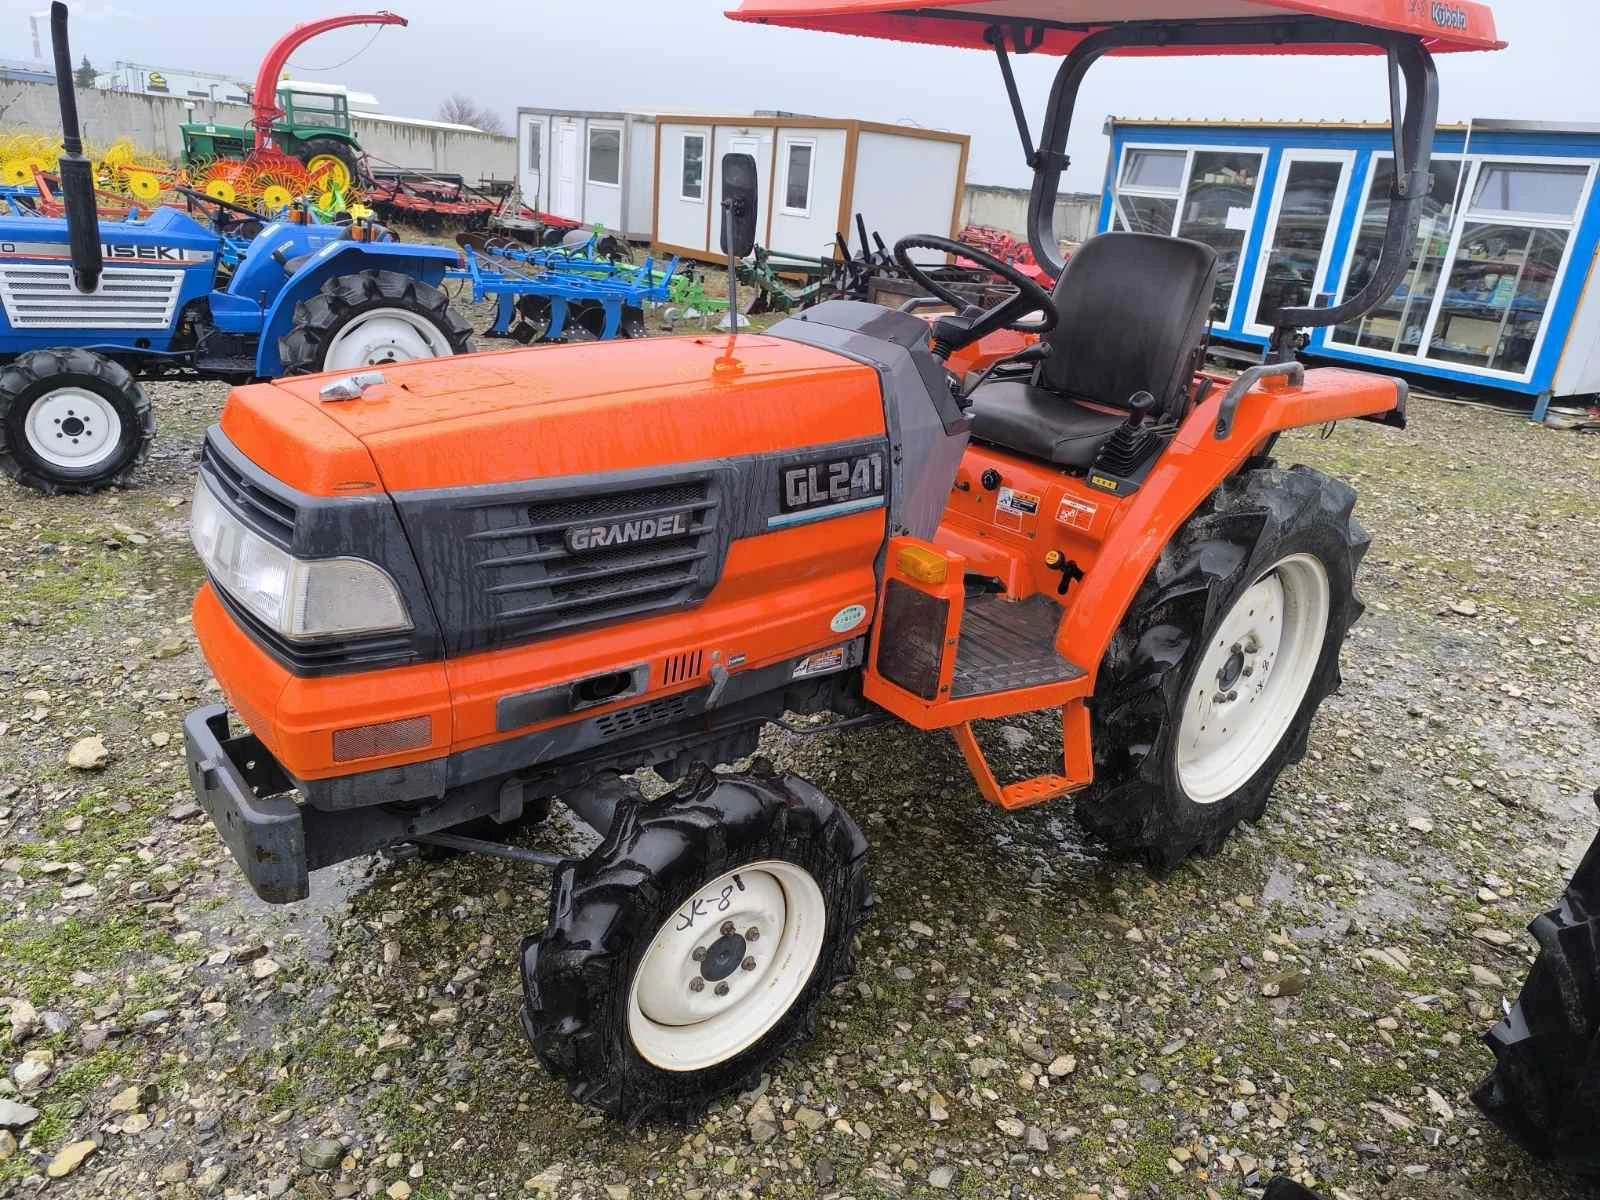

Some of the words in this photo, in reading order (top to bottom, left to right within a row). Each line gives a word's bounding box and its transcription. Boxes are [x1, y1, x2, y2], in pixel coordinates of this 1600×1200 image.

[1431, 2, 1467, 30] Kubota
[106, 244, 185, 260] ISEKI
[785, 453, 882, 507] GL241
[572, 515, 686, 550] GRANDEL
